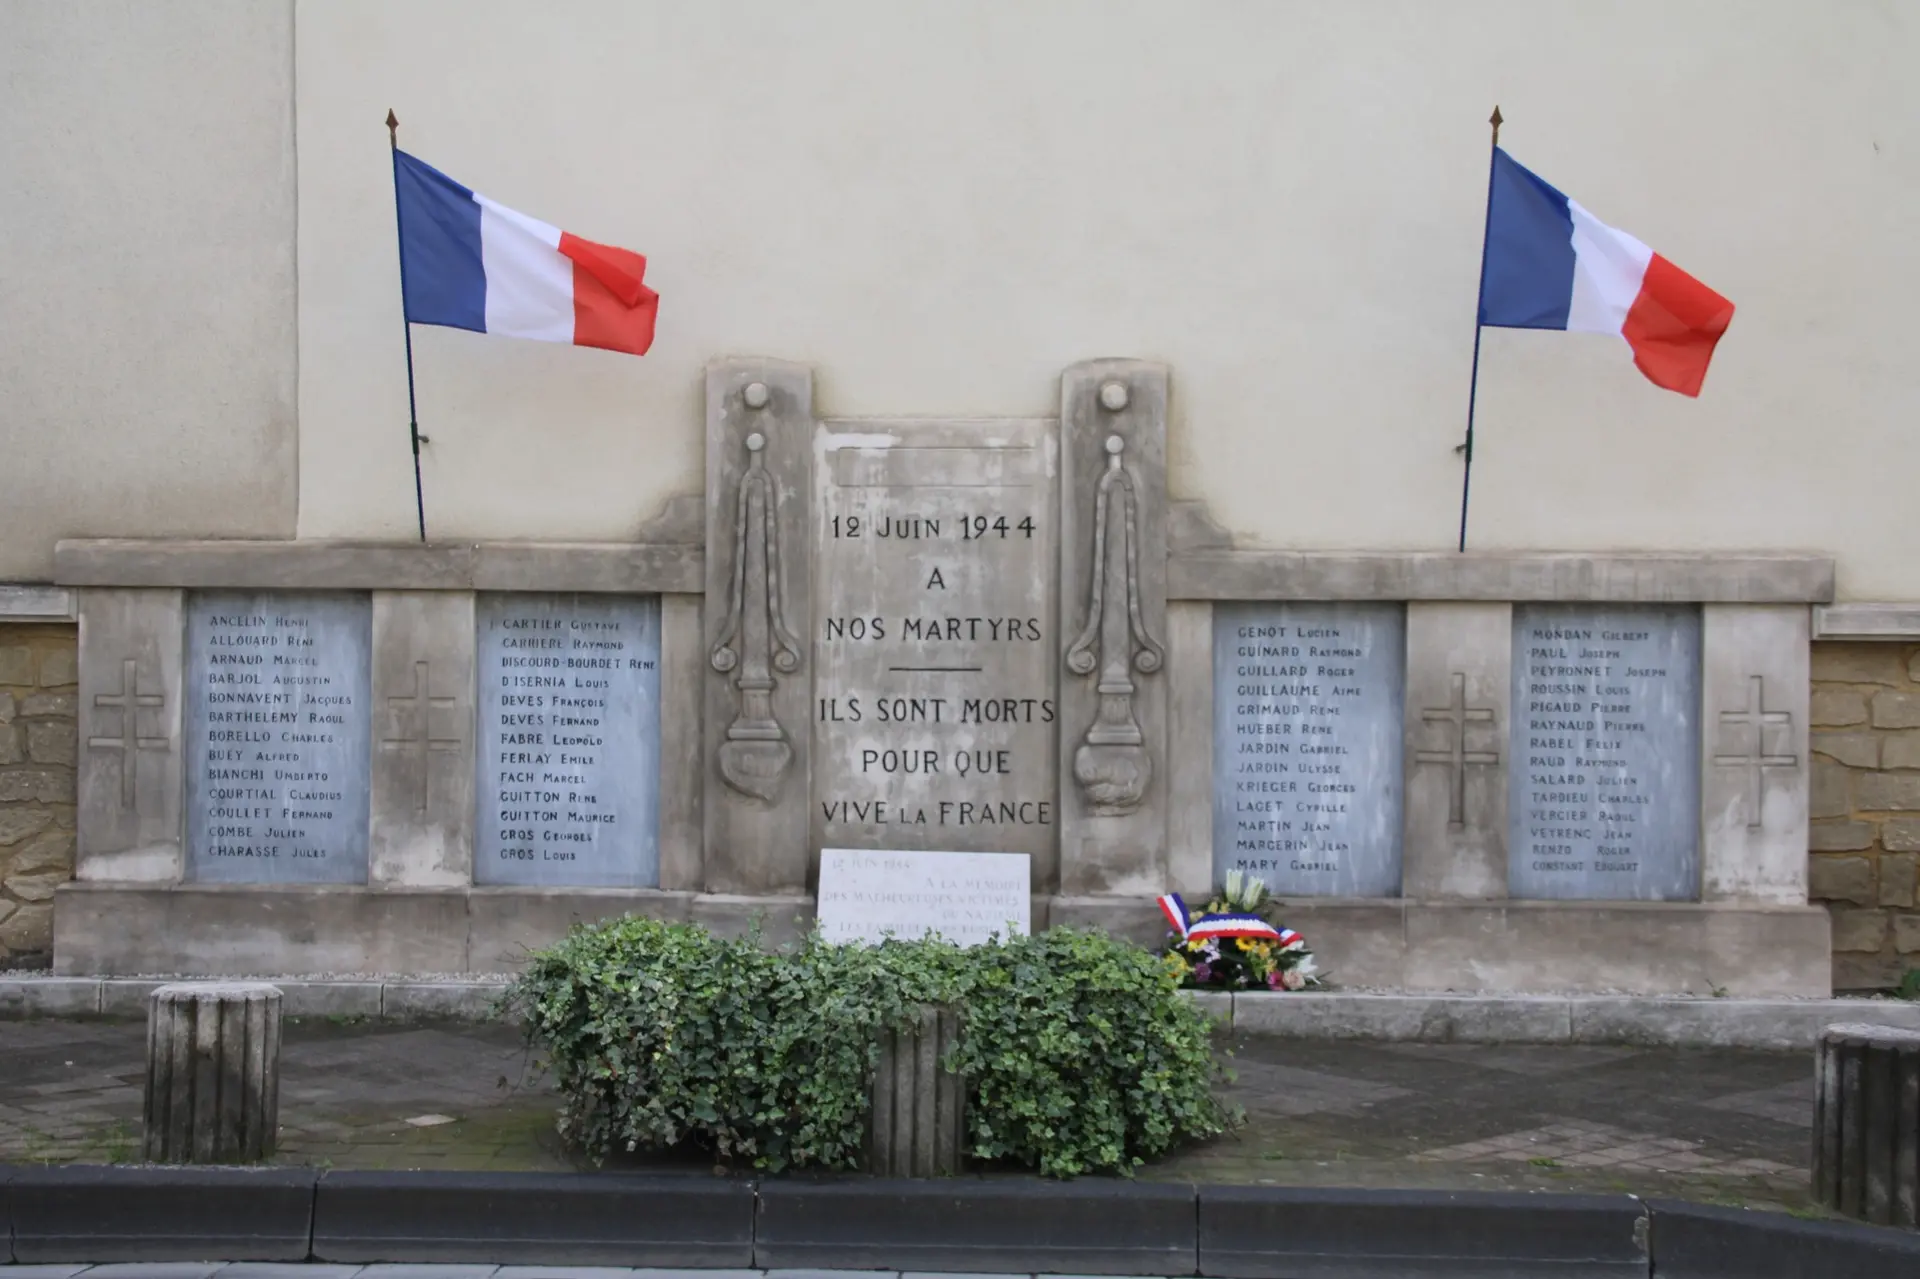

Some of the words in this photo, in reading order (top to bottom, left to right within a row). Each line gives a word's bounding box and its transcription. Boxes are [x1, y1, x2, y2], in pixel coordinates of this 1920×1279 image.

[832, 516, 861, 539] 12
[876, 516, 940, 539] JUIN
[960, 515, 1036, 540] 1944
[927, 567, 945, 590] A
[210, 616, 267, 627] ANCELIN
[502, 619, 562, 629] CARTIER
[827, 617, 885, 641] NOS
[902, 617, 1042, 641] MARTYRS
[1238, 627, 1287, 638] GENOT
[210, 635, 278, 646] ALLOUARD
[1533, 630, 1592, 641] MONDAN
[1237, 646, 1300, 657] GUINARD
[1531, 648, 1568, 659] PAUL
[210, 655, 263, 666] ARNAUD
[1237, 666, 1308, 677] GUILLARD
[1530, 666, 1613, 677] PEYRONNET
[209, 673, 262, 685] BARJOL
[1237, 685, 1320, 696] GUILLAUME
[1530, 684, 1587, 695] ROUSSIN
[209, 693, 293, 704] BONNAVENT
[501, 696, 544, 707] DEVES
[820, 698, 862, 722] ILS
[877, 698, 948, 722] SONT
[961, 699, 1055, 724] MORTS
[1237, 705, 1300, 715] GRIMAUD
[1530, 702, 1582, 713] RIGAUD
[209, 712, 298, 723] BARTHELEMY
[501, 715, 544, 725] DEVES
[1237, 724, 1292, 734] HUEBER
[1530, 720, 1595, 731] RAYNAUD
[209, 731, 271, 742] BORELLO
[501, 733, 544, 744] FABRE
[1237, 744, 1290, 754] JARDIN
[1530, 738, 1574, 749] RABEL
[209, 750, 243, 761] BUEY
[500, 753, 552, 764] FERLAY
[862, 750, 939, 773] POUR
[955, 750, 1011, 777] QUE
[1529, 757, 1566, 767] RAUD
[1237, 763, 1289, 773] JARDIN
[209, 769, 264, 780] BIANCHI
[500, 772, 534, 783] FACH
[1530, 774, 1586, 785] SALARD
[1236, 782, 1297, 792] KRIEGER
[209, 789, 277, 800] COURTIAL
[500, 791, 560, 802] GUITTON
[1532, 792, 1588, 803] TARDIEU
[1236, 801, 1284, 812] LAGET
[209, 808, 272, 818] COULLET
[500, 811, 558, 822] GUITTON
[822, 801, 888, 824] VIVE
[900, 807, 926, 824] LA
[939, 802, 1052, 825] FRANCE
[209, 827, 253, 837] COMBE
[1237, 821, 1292, 832] MARTIN
[500, 830, 535, 841] GROS
[1237, 840, 1308, 851] MARGERIN
[209, 846, 281, 857] CHARASSE
[500, 849, 535, 860] GROS
[1236, 860, 1278, 871] MARY
